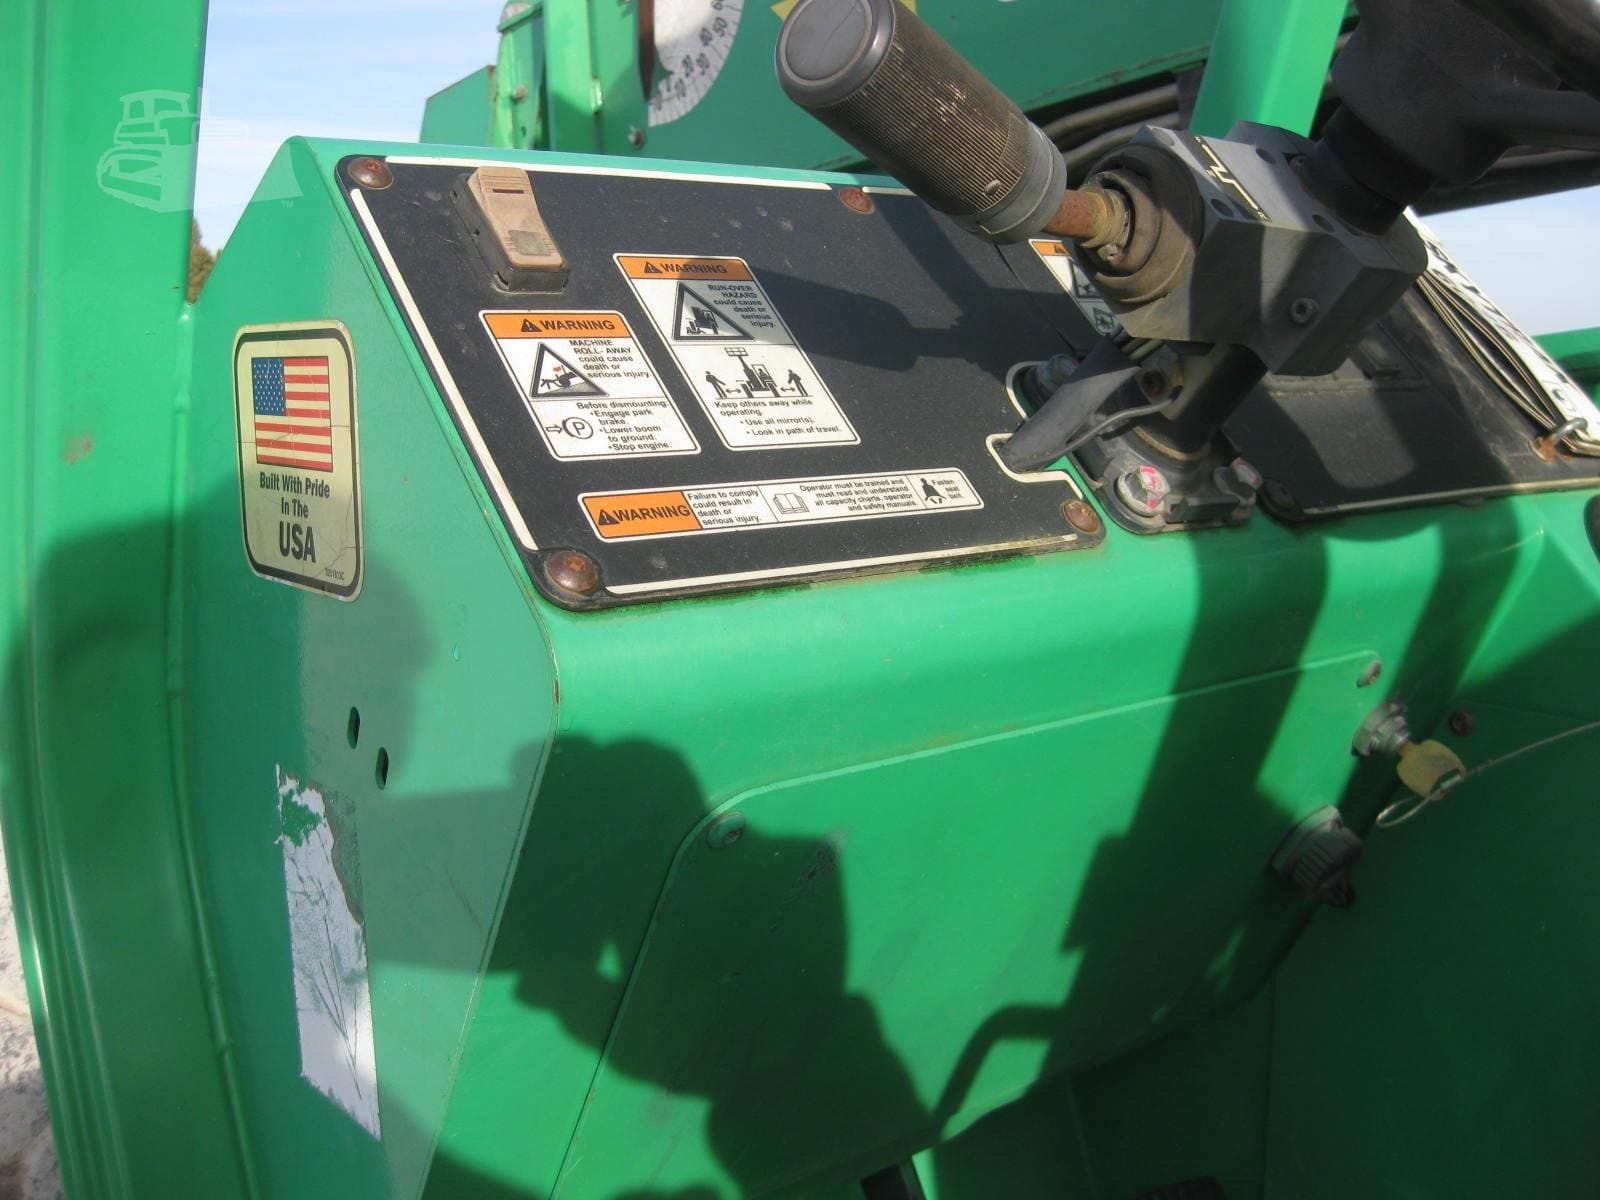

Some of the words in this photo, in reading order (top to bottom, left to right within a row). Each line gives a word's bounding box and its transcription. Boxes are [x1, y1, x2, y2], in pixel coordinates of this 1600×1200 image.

[712, 17, 728, 38] 50
[661, 263, 727, 274] WARNING
[708, 284, 753, 292] RUN-OVER
[540, 320, 615, 331] WARNING
[750, 320, 776, 329] injury.
[578, 355, 605, 363] could
[623, 371, 652, 380] injury.
[576, 402, 608, 410] Before
[714, 401, 737, 410] Keep
[739, 400, 766, 408] others
[769, 400, 790, 409] away
[791, 399, 813, 407] while
[632, 409, 653, 417] park
[720, 408, 763, 417] operating.
[599, 418, 629, 426] brake.
[776, 416, 815, 425] mirror(s).
[634, 425, 662, 433] boom
[752, 428, 774, 436] Look
[786, 427, 804, 436] path
[815, 425, 842, 433] travel.
[620, 434, 657, 443] ground.
[638, 442, 672, 451] engine.
[259, 471, 280, 491] Built
[282, 473, 303, 494] With
[305, 476, 331, 499] Pride
[799, 484, 833, 492] Operator
[864, 479, 890, 487] trained
[687, 492, 717, 500] Failure
[728, 489, 759, 498] comply
[836, 489, 853, 497] read
[869, 486, 909, 494] understand
[693, 500, 717, 509] could
[718, 498, 742, 507] result
[825, 498, 857, 507] capacity
[883, 493, 913, 501] operator
[281, 496, 290, 516] In
[292, 498, 309, 519] The
[863, 502, 886, 510] safety
[614, 505, 690, 521] WARNING
[697, 508, 721, 517] death
[702, 517, 734, 525] serious
[734, 515, 762, 524] injury.
[279, 520, 316, 563] USA
